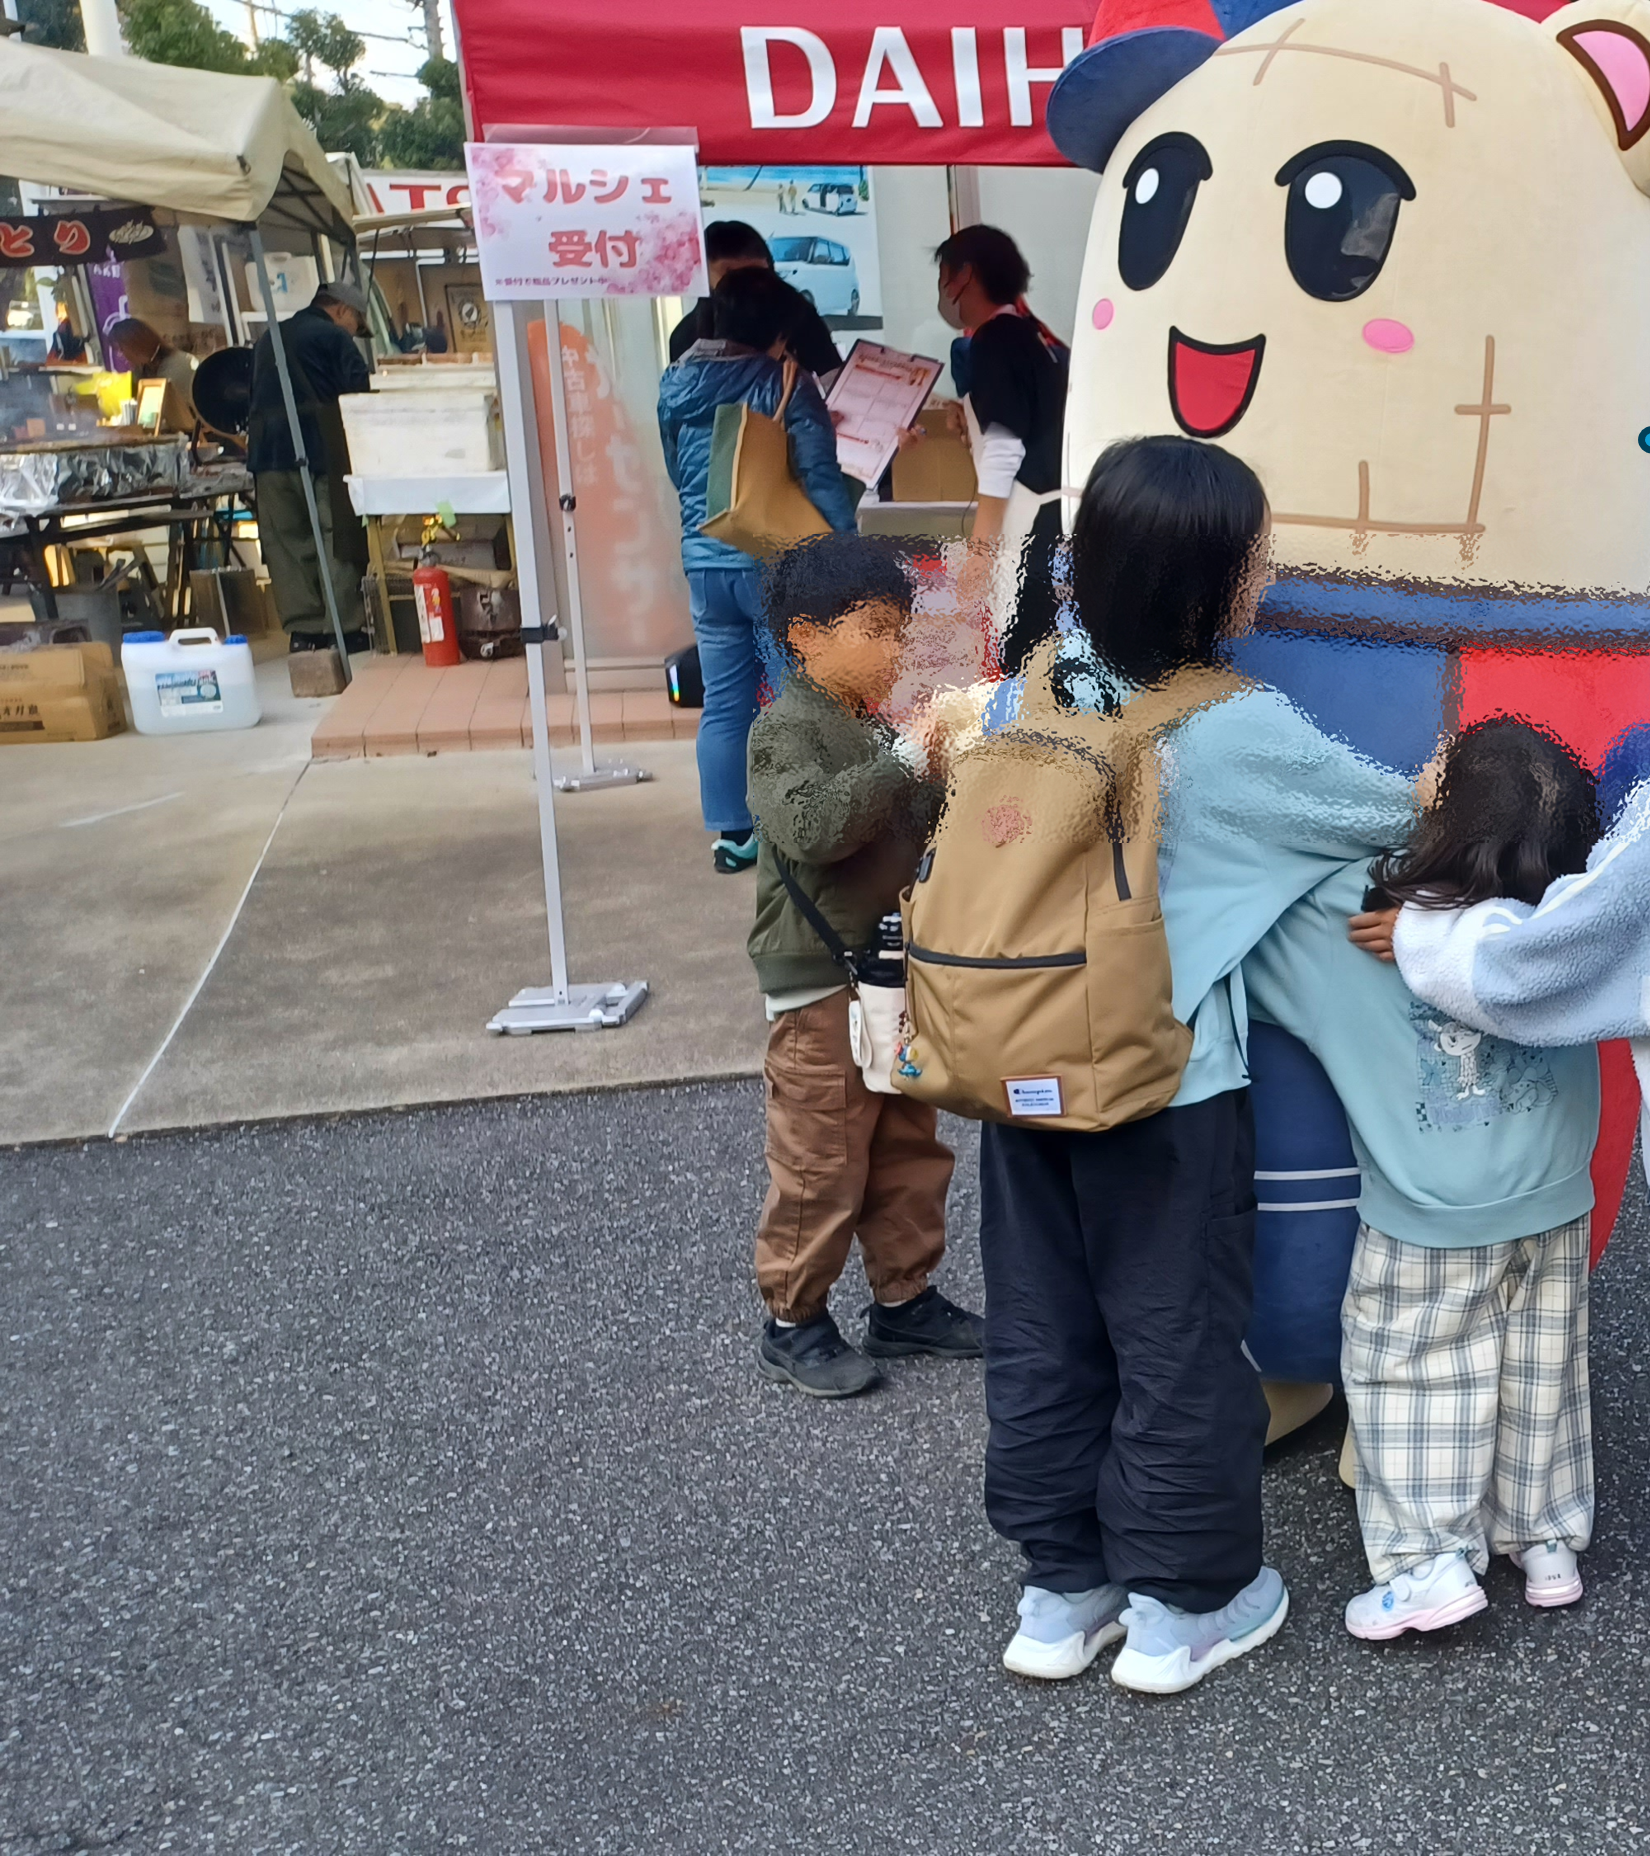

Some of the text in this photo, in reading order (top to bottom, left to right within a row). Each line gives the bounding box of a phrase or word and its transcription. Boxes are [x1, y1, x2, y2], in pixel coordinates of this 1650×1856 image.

[740, 26, 1084, 129] DAIH
[495, 169, 672, 204] マルシェ
[549, 229, 640, 268] 受付
